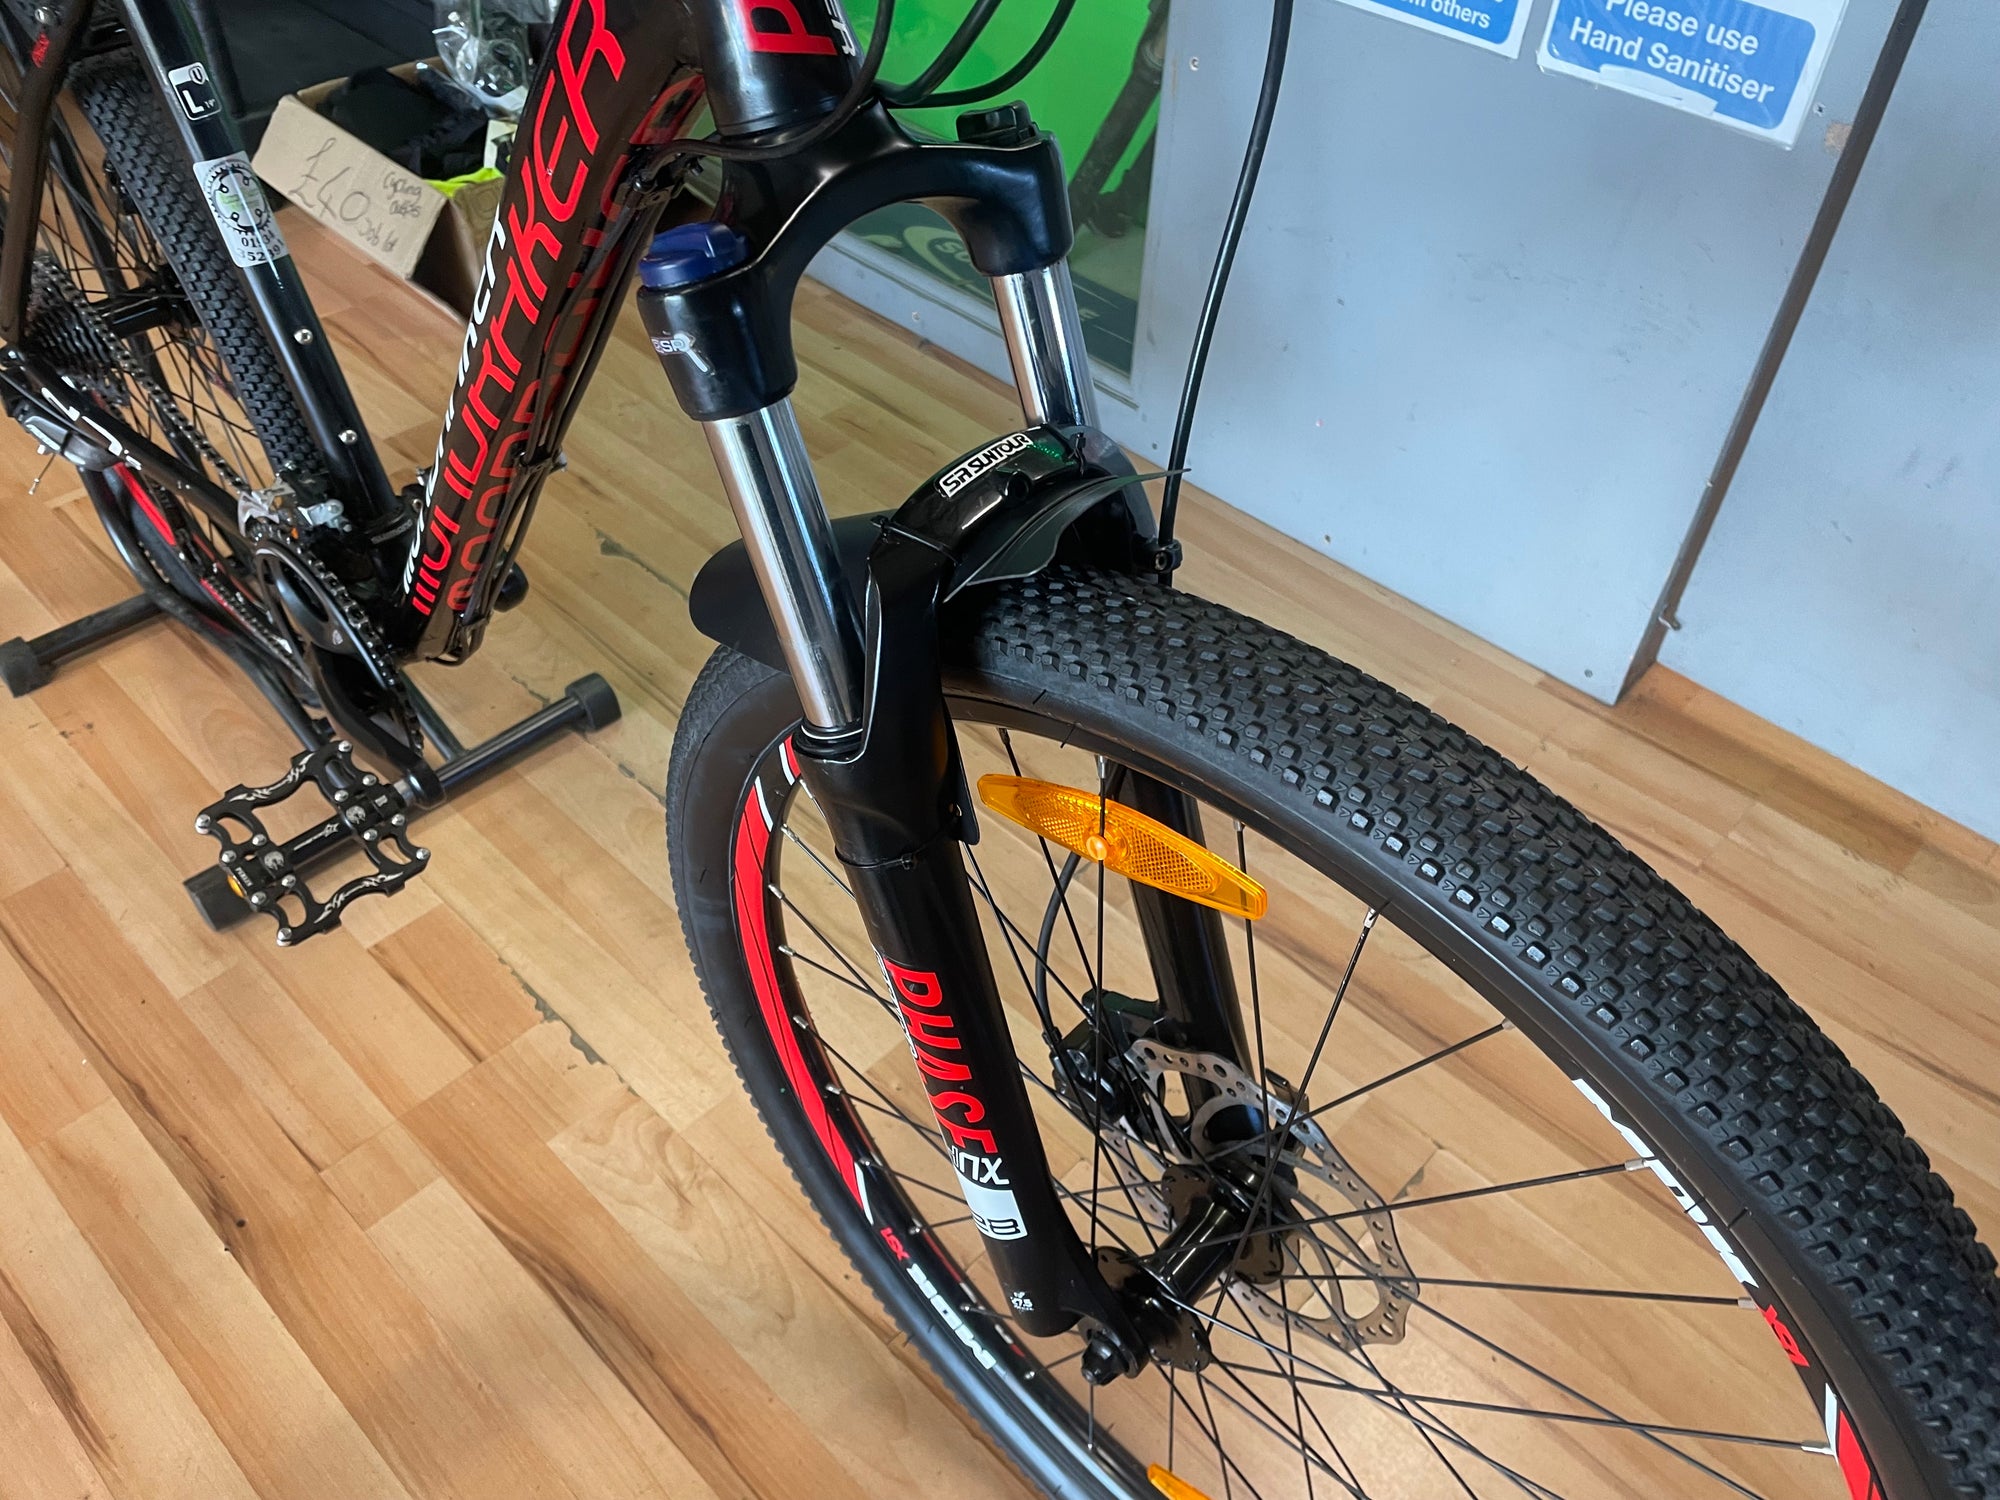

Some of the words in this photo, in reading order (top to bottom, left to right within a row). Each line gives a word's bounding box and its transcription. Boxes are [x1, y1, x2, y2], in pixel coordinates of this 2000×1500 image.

[1431, 0, 1492, 29] others
[1569, 16, 1644, 62] Hand
[1646, 42, 1775, 104] Sanitiser
[1705, 23, 1759, 56] use
[182, 89, 205, 114] L
[288, 137, 371, 221] £40
[942, 467, 974, 493] SR
[967, 433, 1030, 475] SUNTOUR
